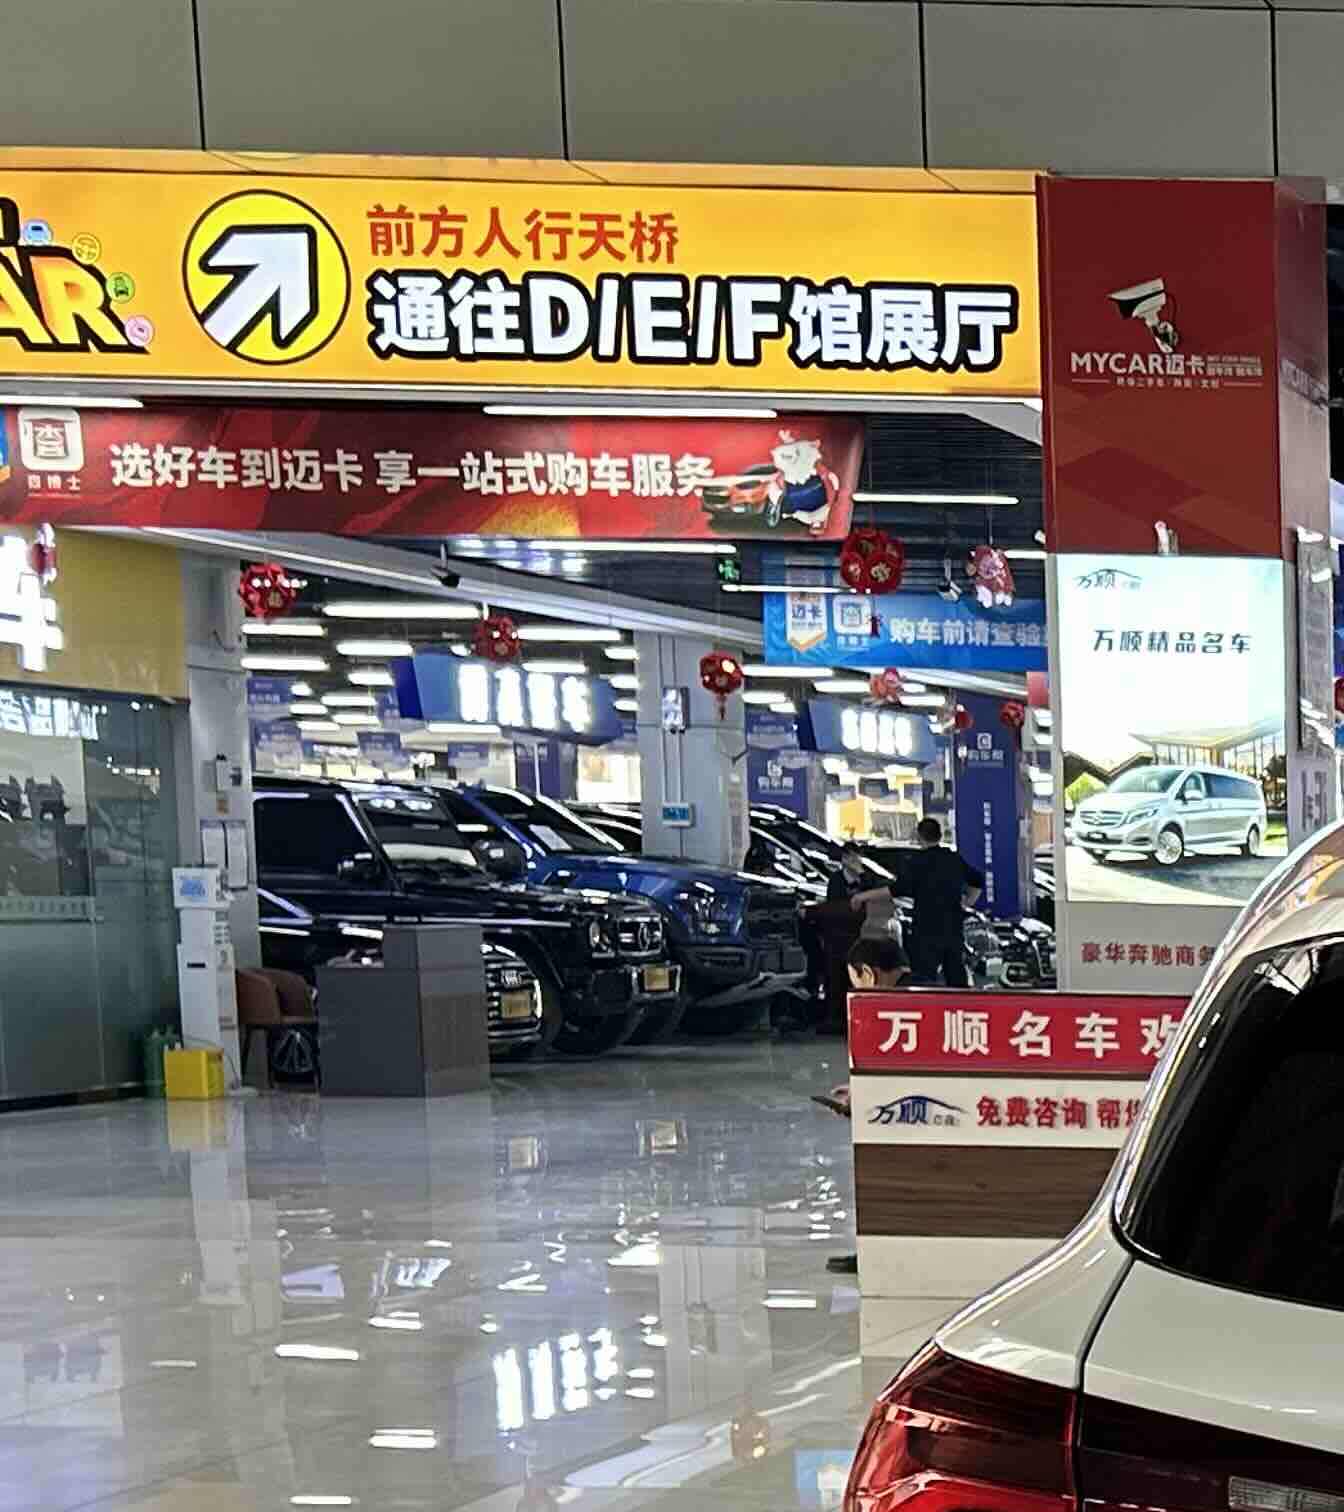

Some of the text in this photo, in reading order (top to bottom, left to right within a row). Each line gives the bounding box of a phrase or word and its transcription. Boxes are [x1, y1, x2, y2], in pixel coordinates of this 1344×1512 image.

[366, 204, 679, 265] 前方人行天桥
[371, 270, 1014, 371] 通往D/E/F馆展厅
[109, 443, 713, 499] 选好车到迈卡 享一站式购车服务
[888, 617, 1048, 648] 购车前请查验
[1093, 629, 1253, 655] 万顺精品名车
[976, 1095, 1088, 1129] 免费咨询
